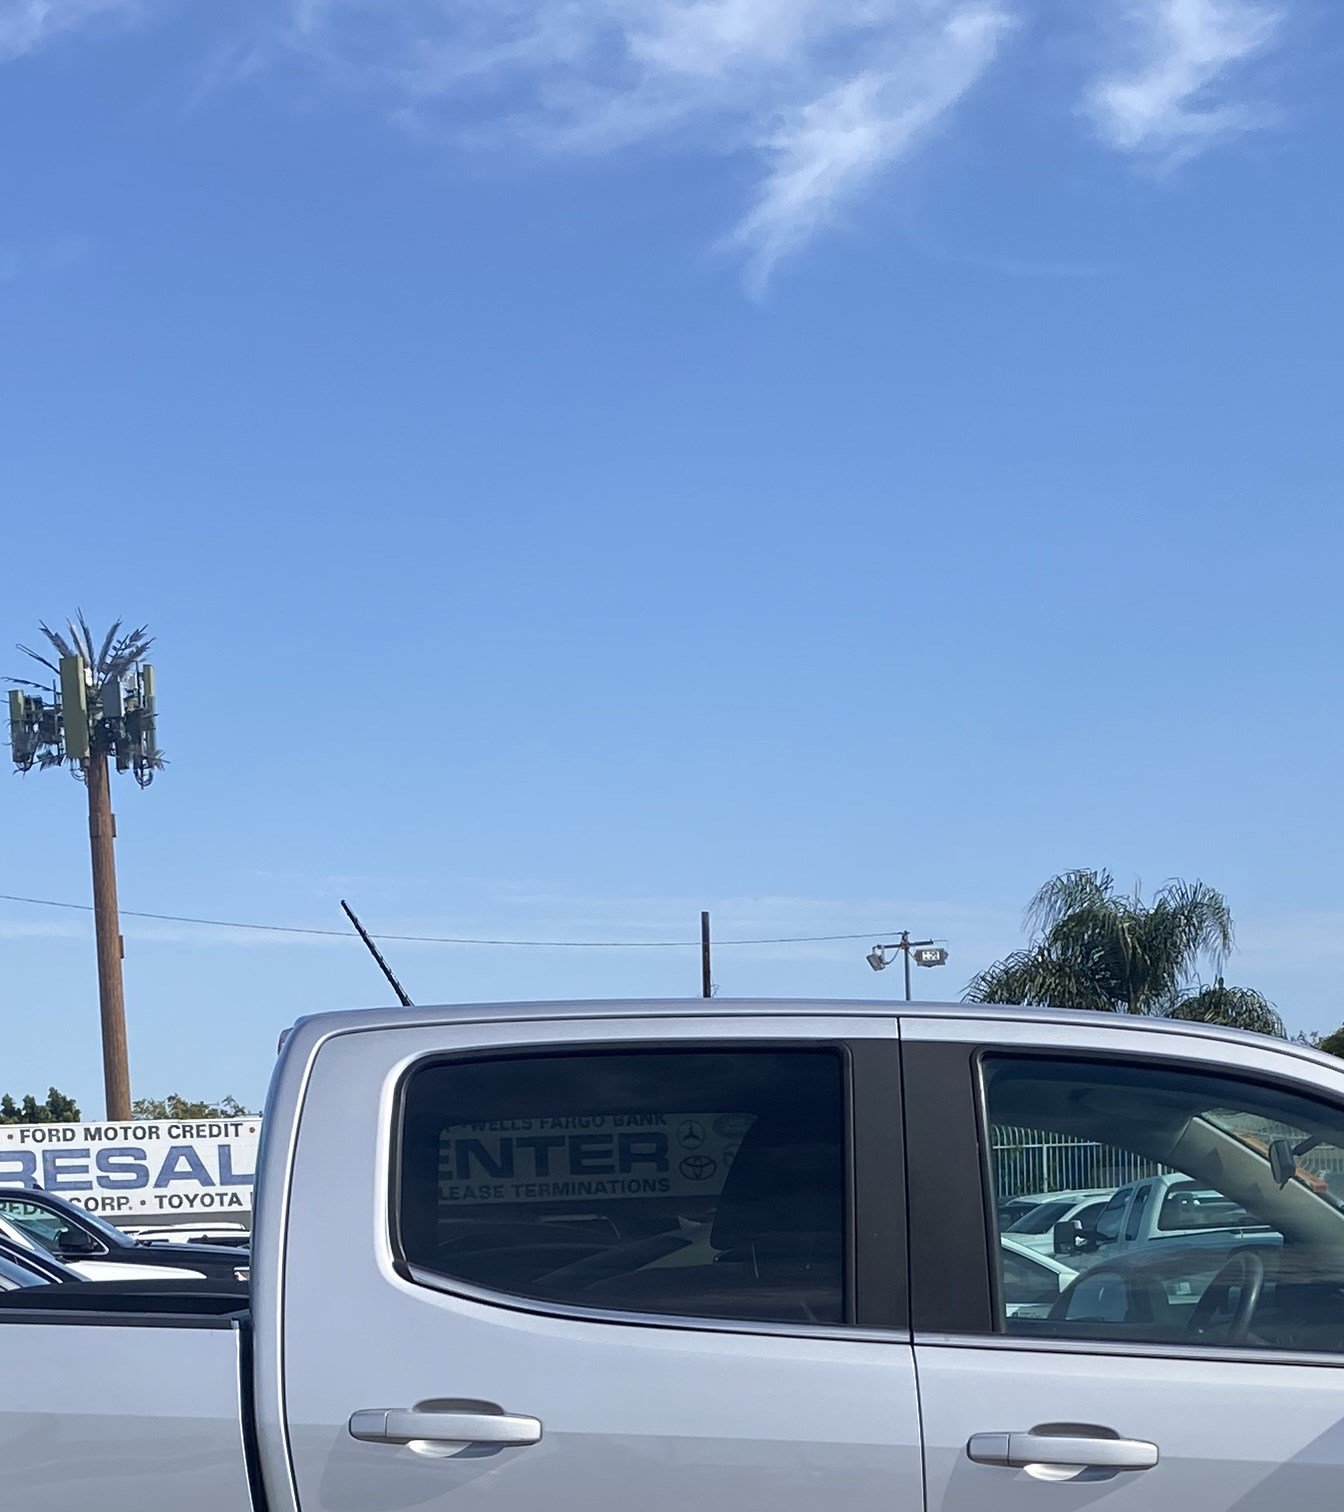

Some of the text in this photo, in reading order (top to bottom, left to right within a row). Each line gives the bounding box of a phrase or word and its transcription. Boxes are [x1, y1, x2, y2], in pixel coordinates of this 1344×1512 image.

[540, 1114, 605, 1130] FARGO
[613, 1111, 668, 1127] BANK
[19, 1122, 244, 1144] FORD MOTOR CREDIT
[439, 1131, 670, 1182] ENTER
[514, 1178, 671, 1198] TERMINATIONS
[154, 1192, 243, 1209] TOYOTA
